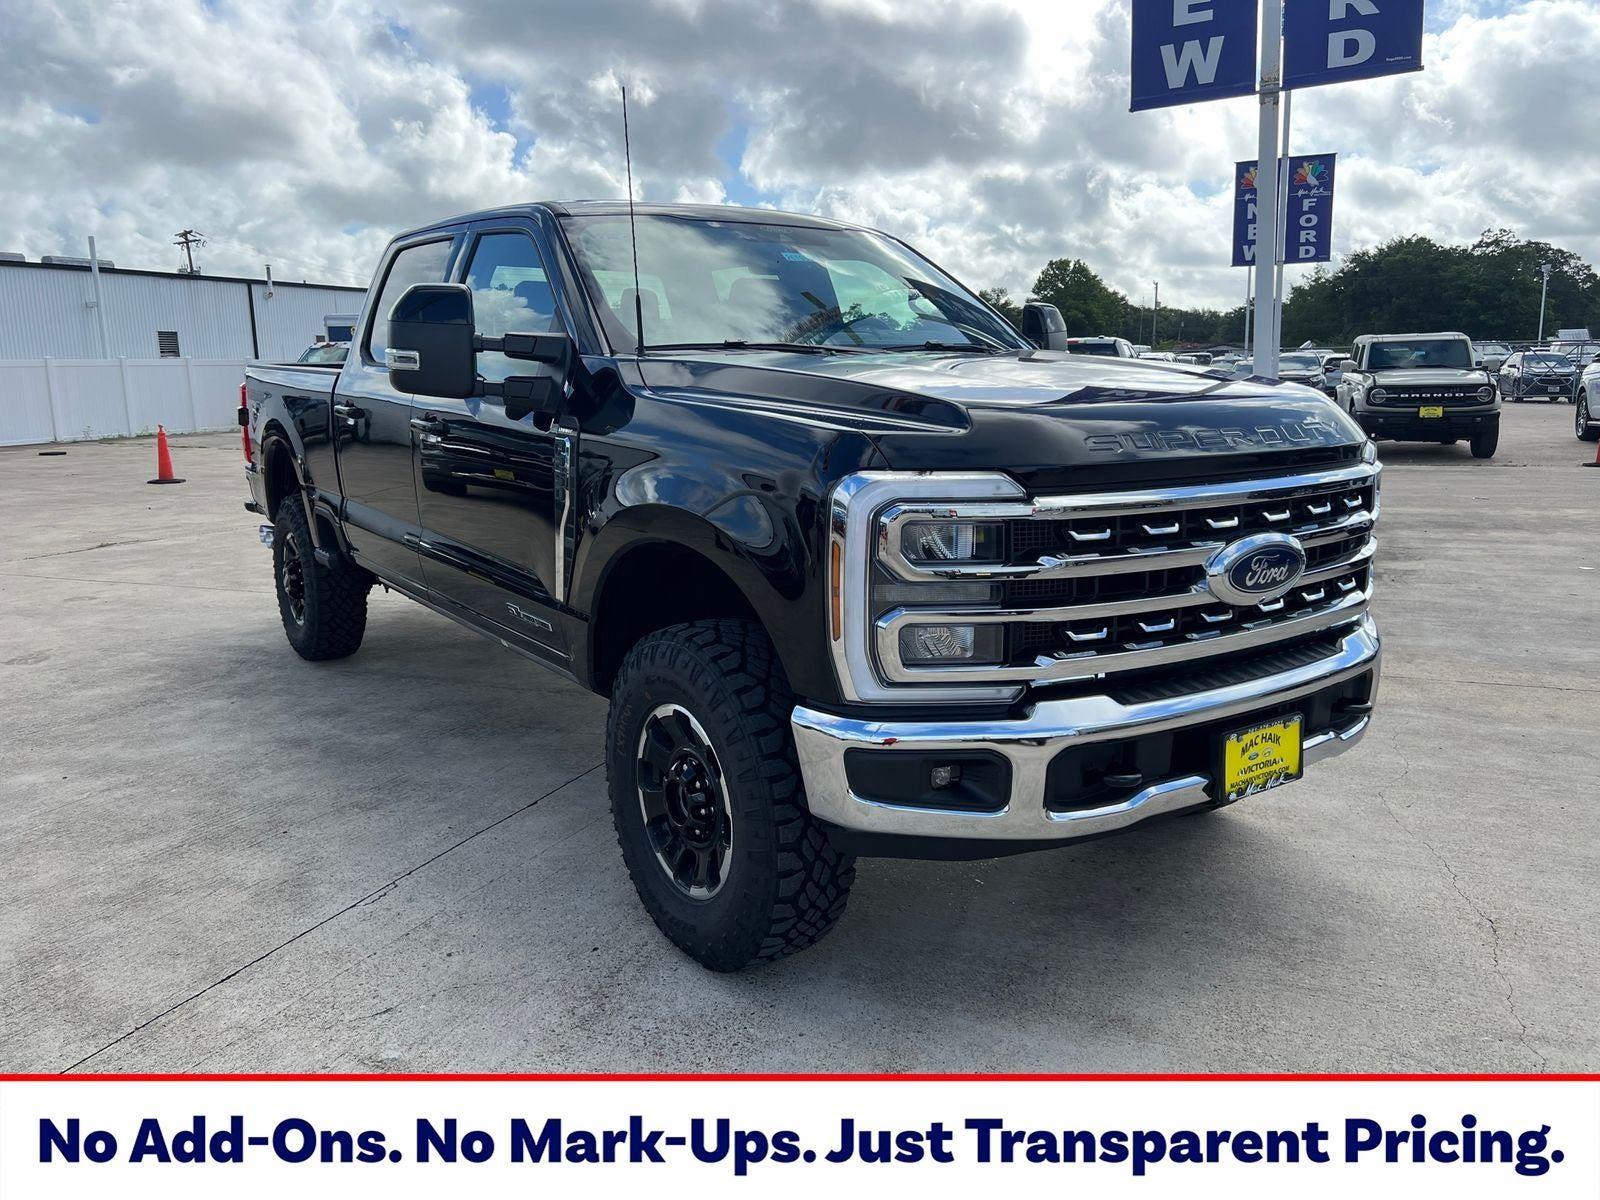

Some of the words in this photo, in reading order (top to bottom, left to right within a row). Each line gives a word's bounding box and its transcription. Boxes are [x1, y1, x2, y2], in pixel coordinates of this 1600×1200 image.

[1298, 198, 1318, 259] FORD
[1084, 427, 1254, 453] SUPER
[1254, 419, 1341, 445] DUTY
[1246, 554, 1290, 587] Ford
[1240, 734, 1260, 758] MAC
[1260, 732, 1281, 746] HAIK
